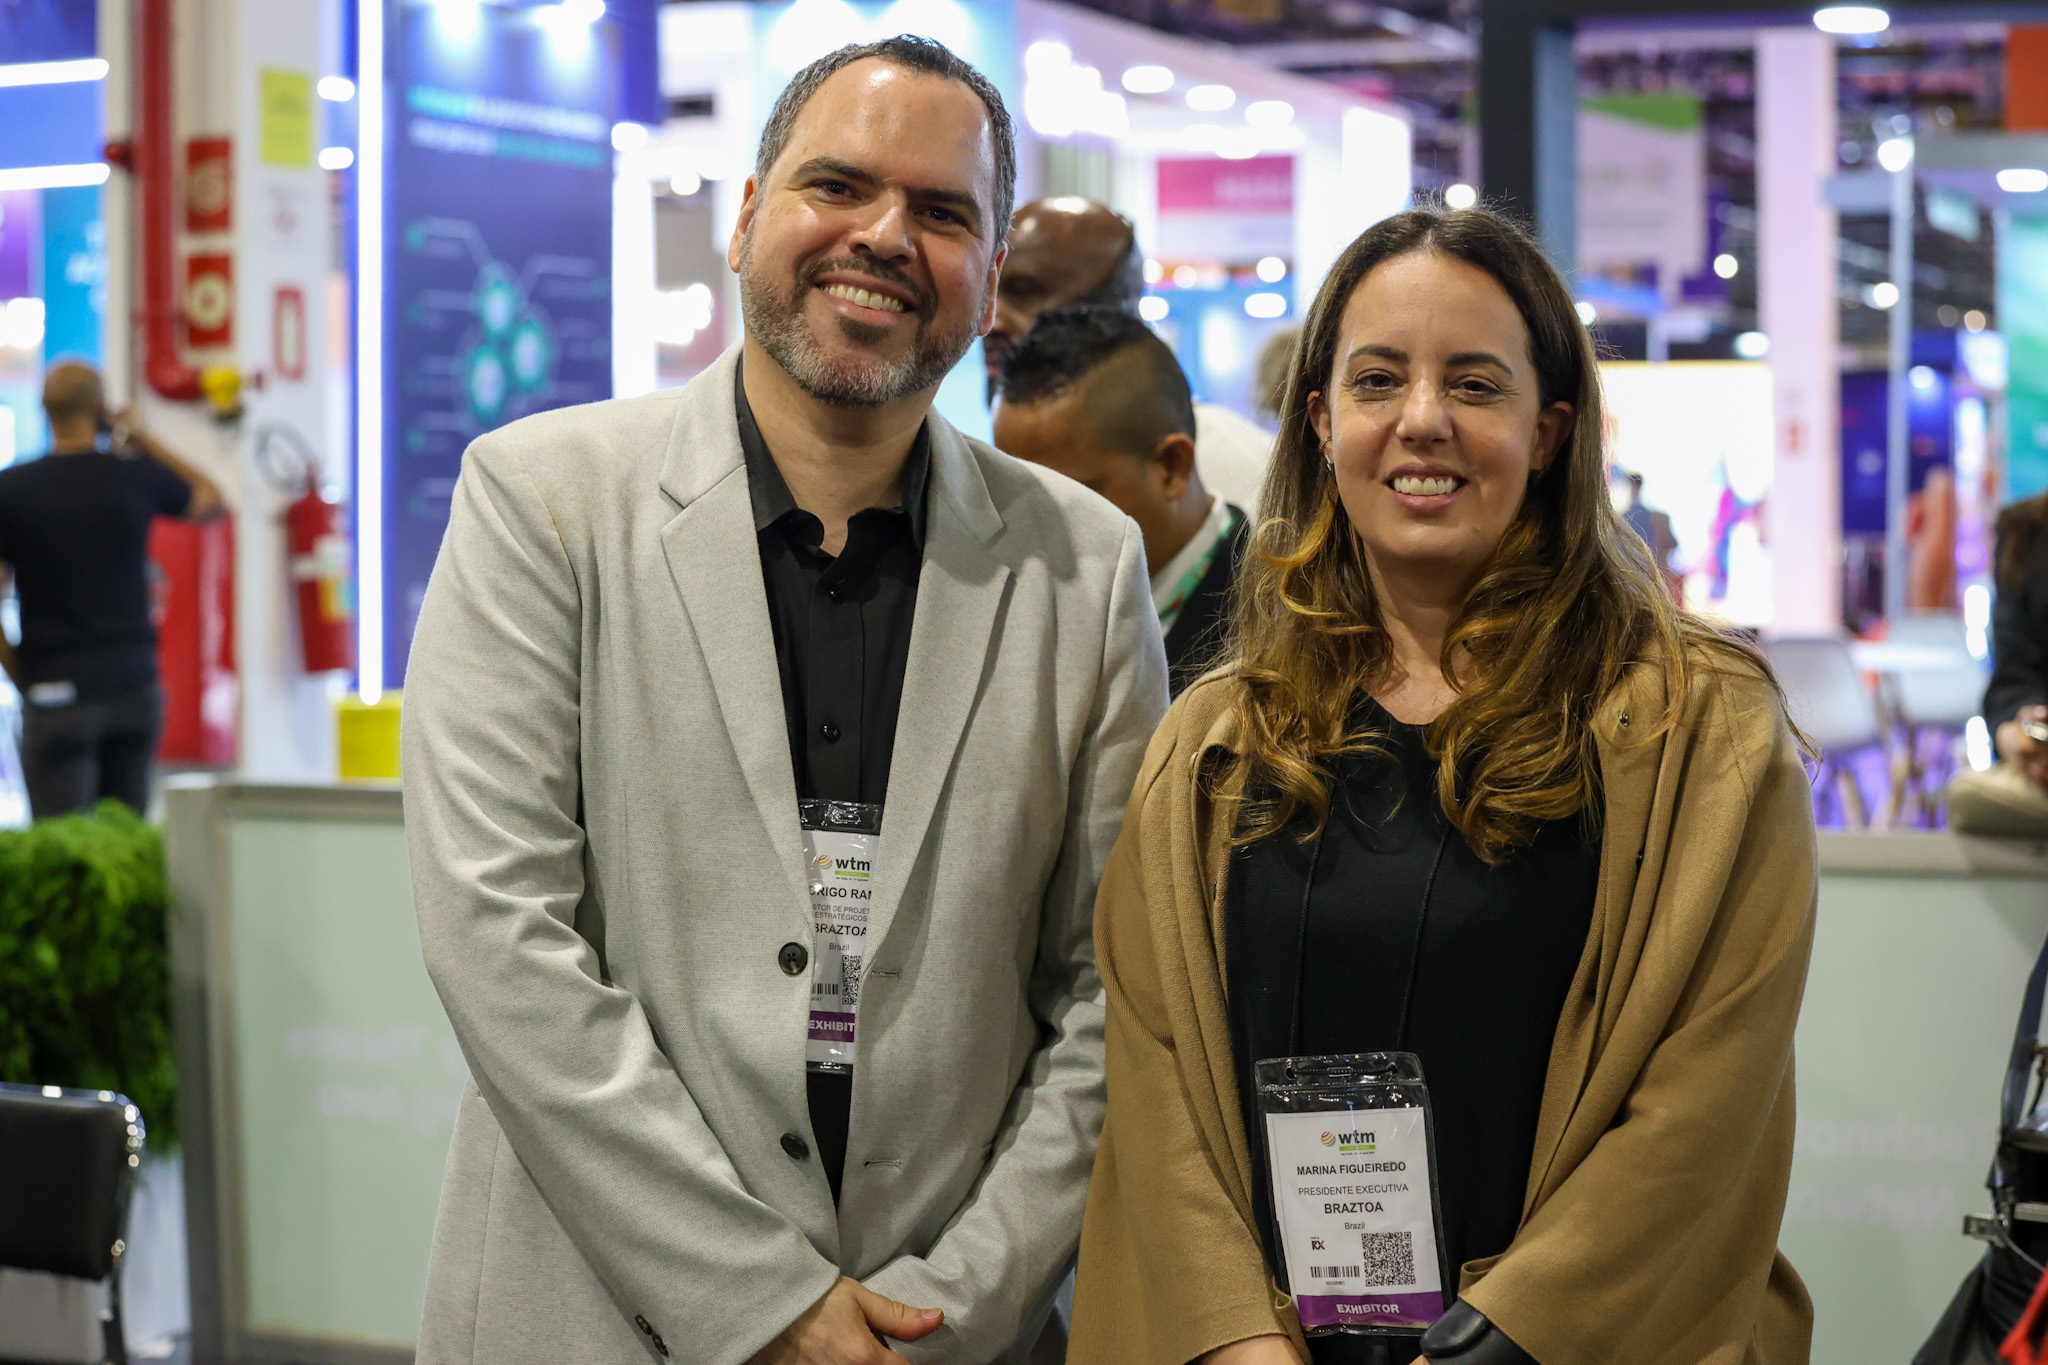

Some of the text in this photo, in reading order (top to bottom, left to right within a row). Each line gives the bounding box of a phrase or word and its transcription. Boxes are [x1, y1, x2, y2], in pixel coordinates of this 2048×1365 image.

[836, 857, 871, 871] wtm
[815, 911, 868, 921] ESTRATÉGICOS
[829, 943, 850, 951] Brazil
[1338, 1130, 1375, 1144] wtm
[1297, 1161, 1406, 1175] MARINA FIGUEIREDO
[1298, 1183, 1409, 1196] PRESIDENTE EXECUTIVA
[1324, 1201, 1384, 1214] BRAZTOA
[1344, 1222, 1366, 1230] Brazil
[1336, 1303, 1400, 1315] EXHIBITOR
